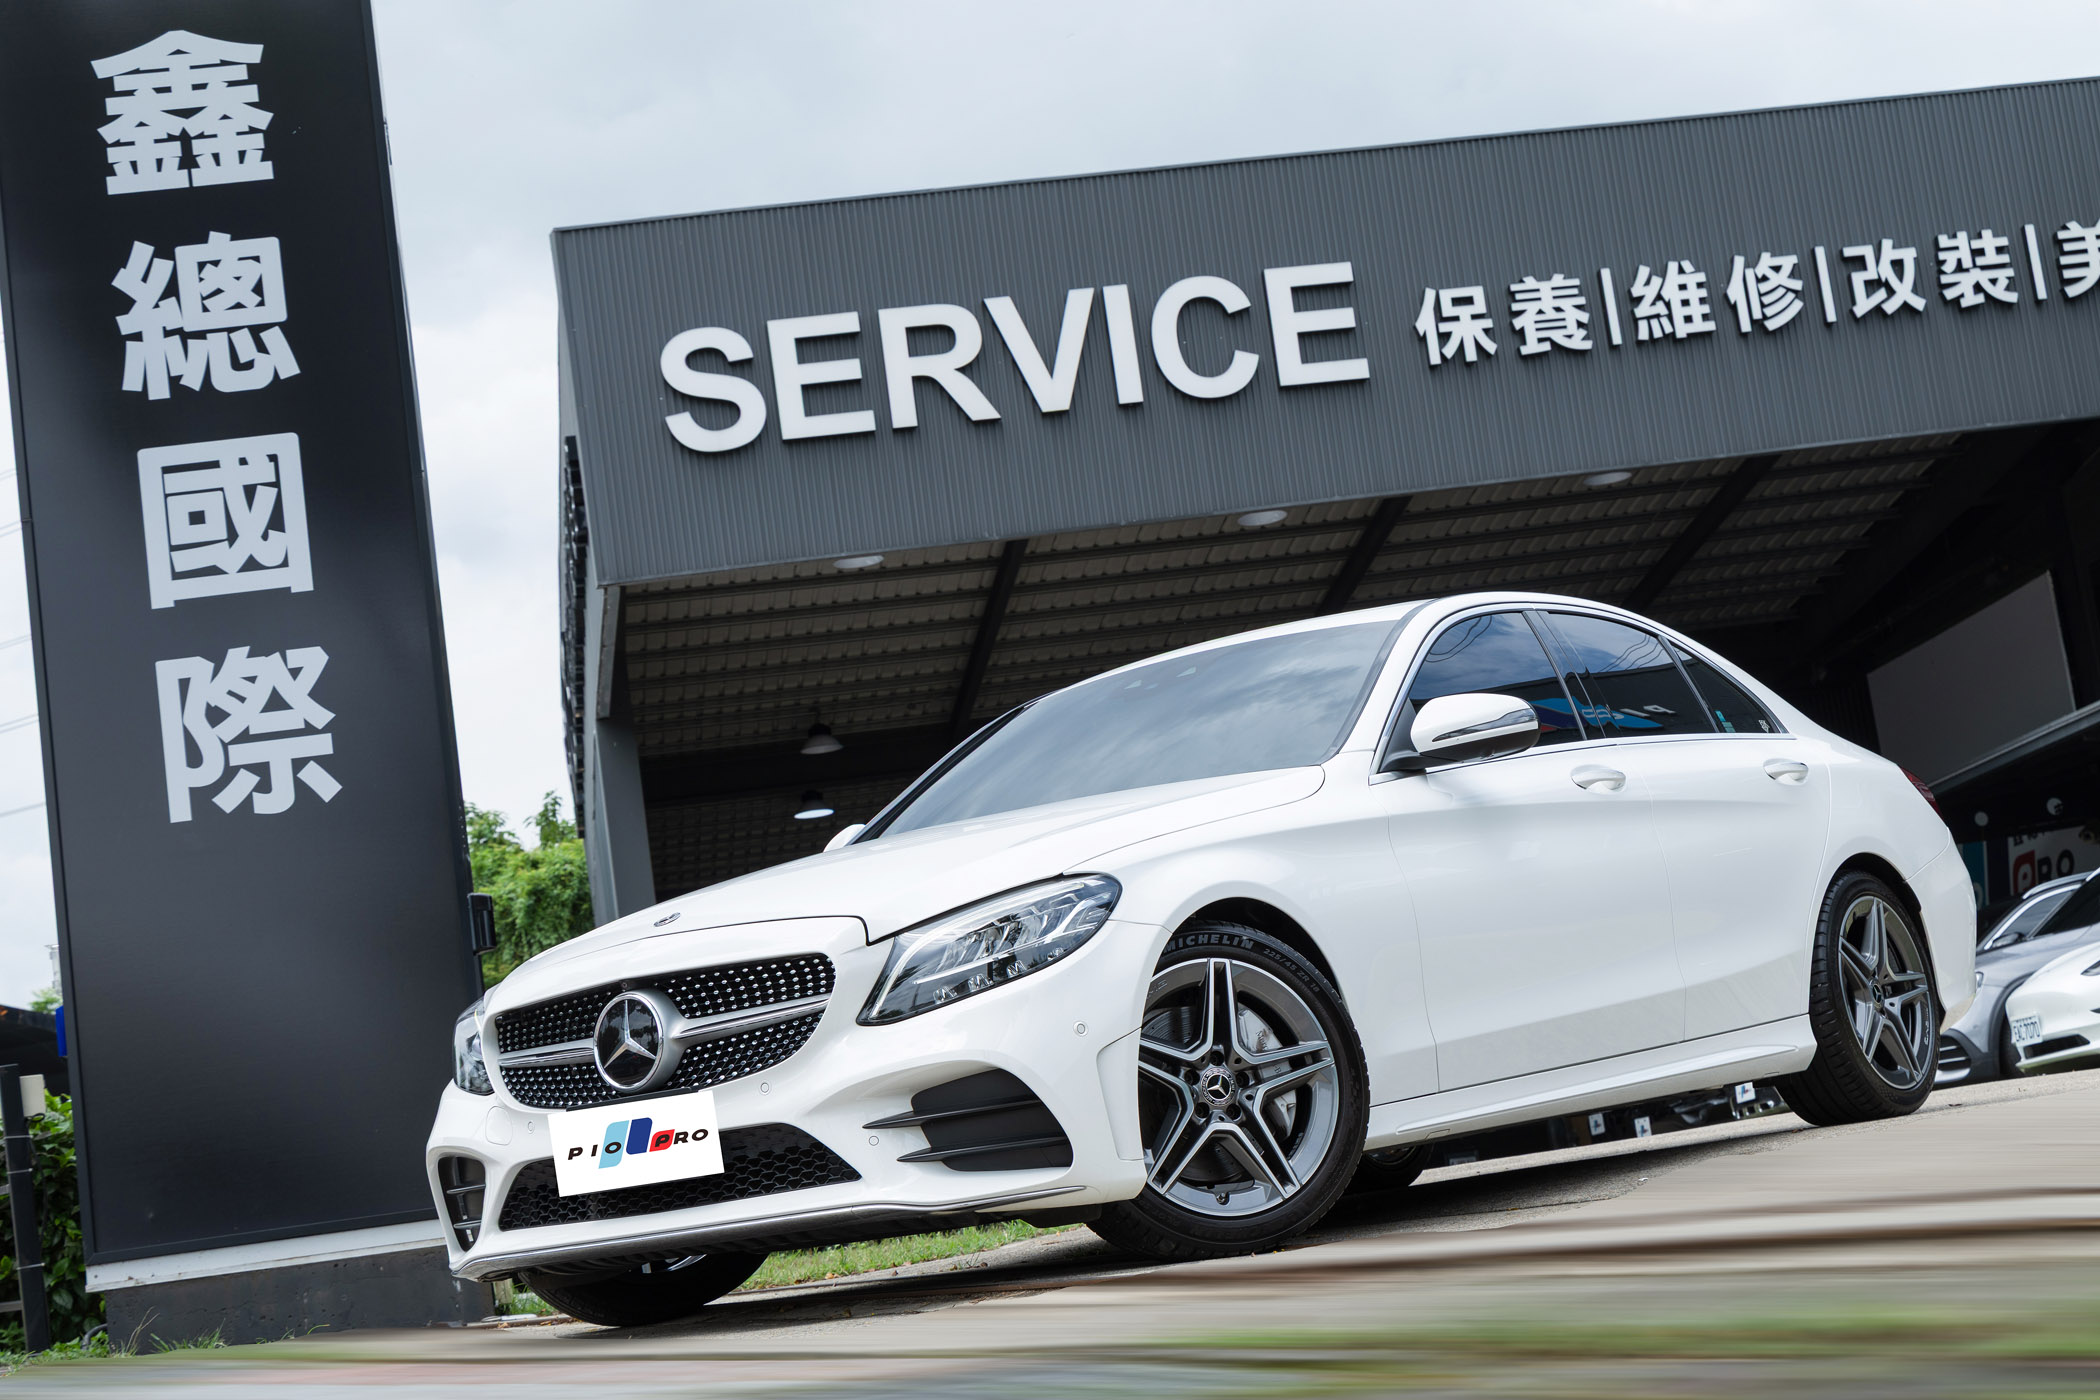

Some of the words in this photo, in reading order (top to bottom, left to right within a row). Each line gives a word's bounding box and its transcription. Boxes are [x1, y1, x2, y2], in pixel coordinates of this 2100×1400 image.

[92, 30, 342, 824] 鑫總國際
[660, 261, 1370, 453] SERVICE
[1163, 933, 1255, 954] MICHELIN
